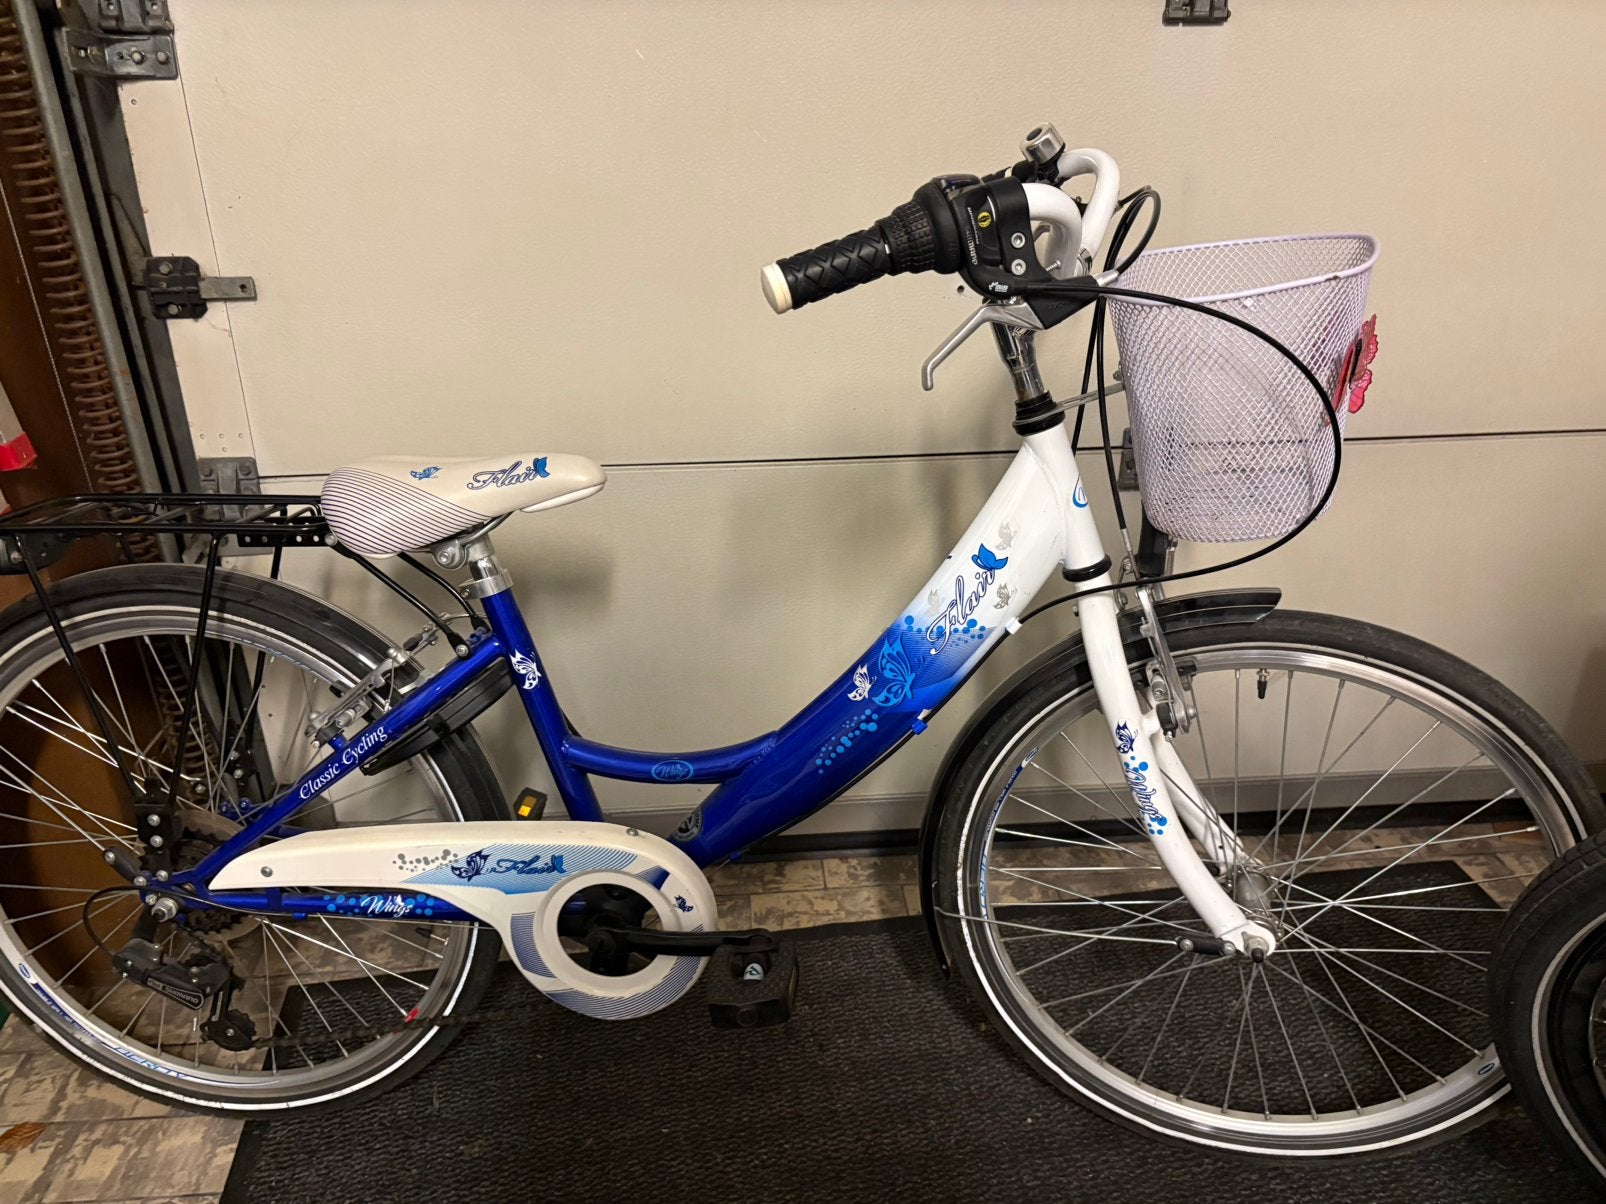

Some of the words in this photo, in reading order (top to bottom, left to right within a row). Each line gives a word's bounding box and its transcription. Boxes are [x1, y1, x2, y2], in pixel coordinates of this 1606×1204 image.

[467, 461, 541, 490] Flair
[926, 575, 996, 655] Flair
[299, 763, 341, 799] Classic
[341, 725, 388, 764] Cycling
[1124, 767, 1164, 821] Wings
[490, 855, 556, 874] Flair
[360, 895, 414, 918] Wings
